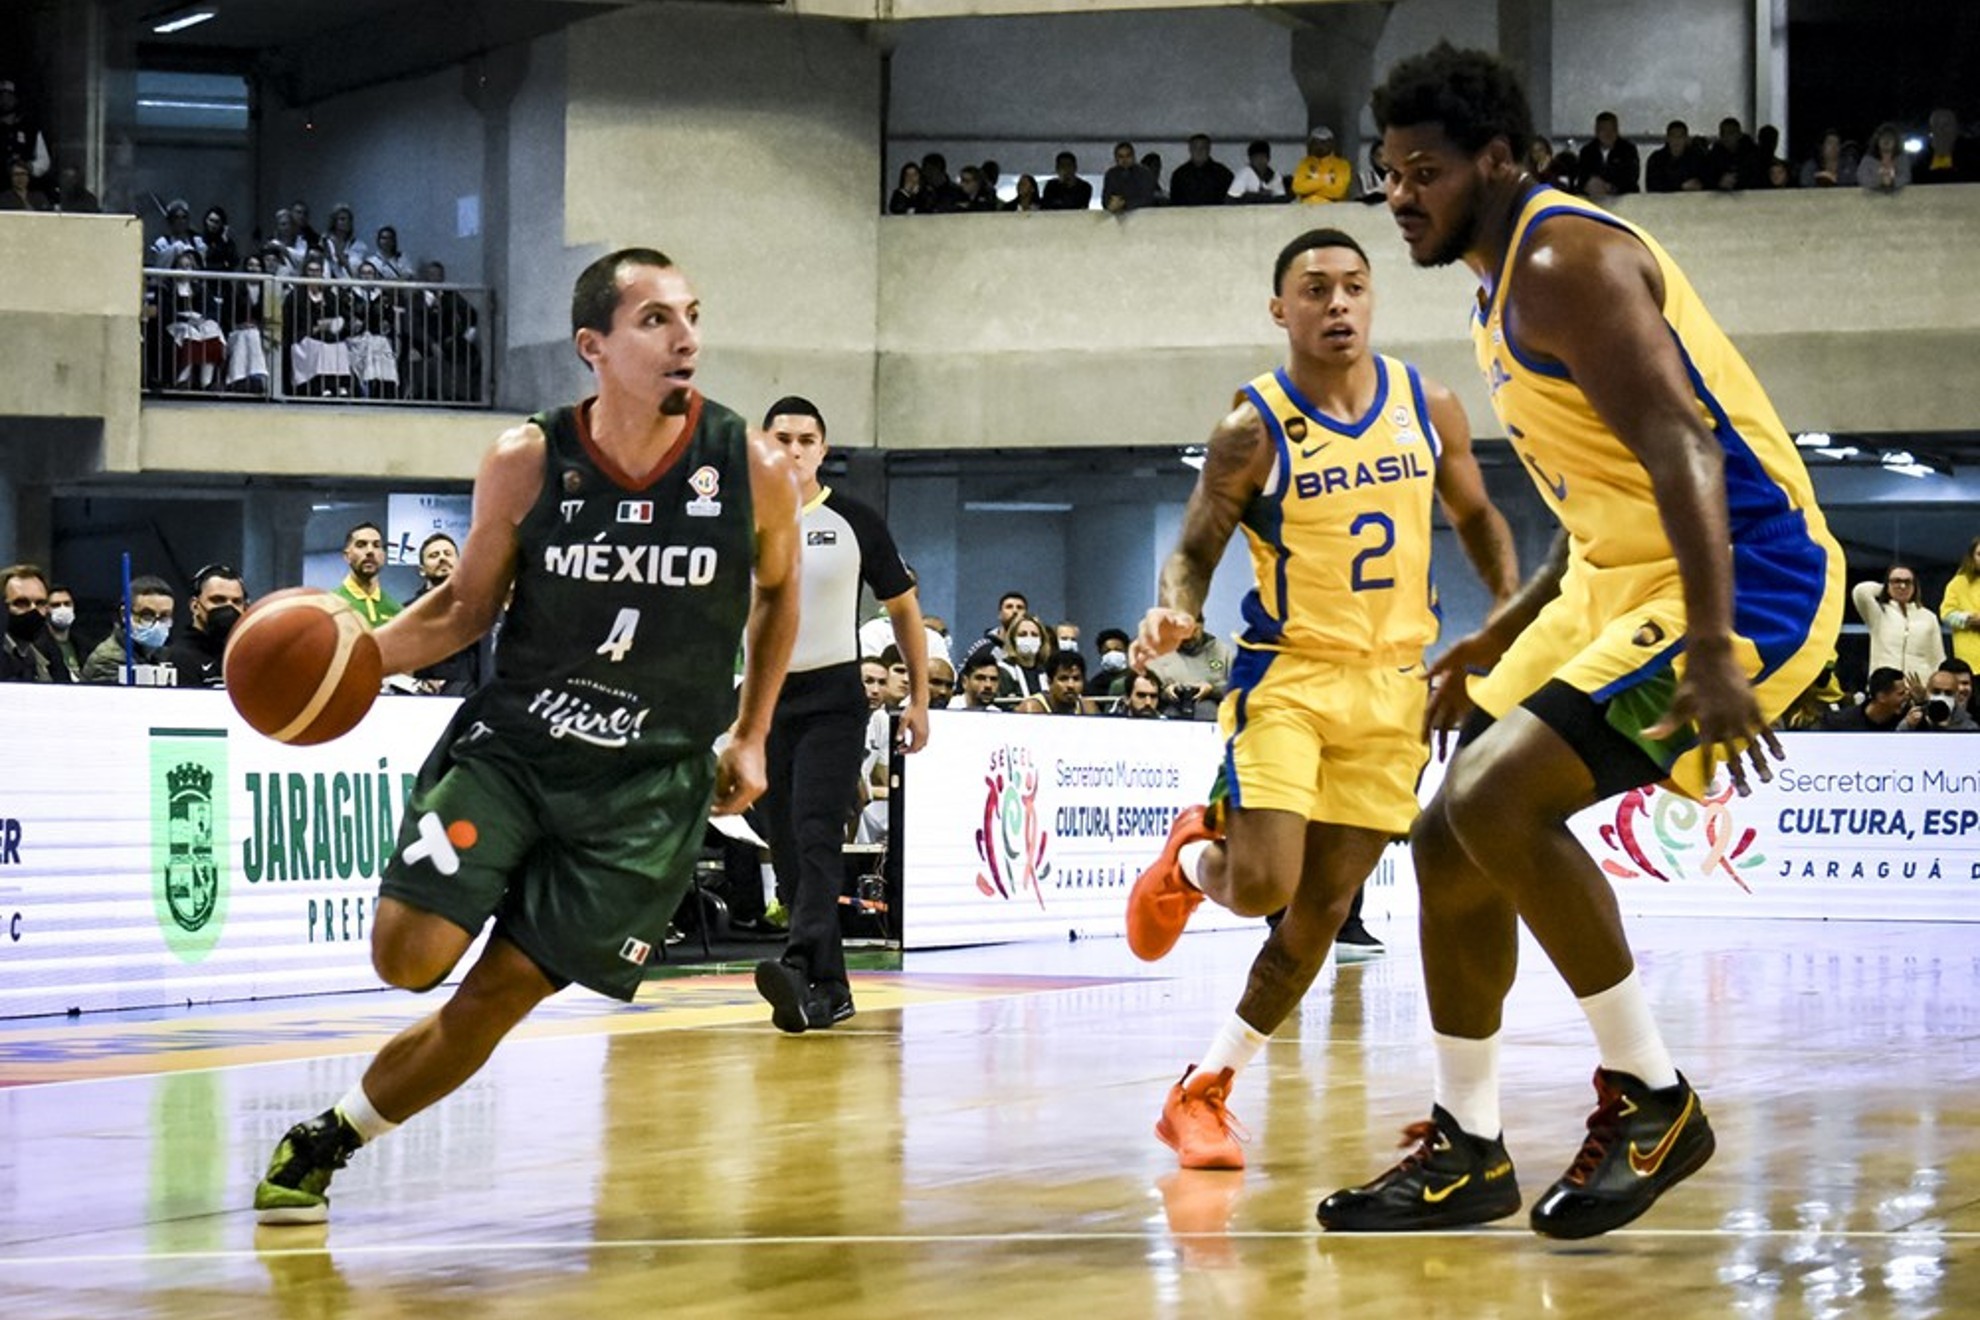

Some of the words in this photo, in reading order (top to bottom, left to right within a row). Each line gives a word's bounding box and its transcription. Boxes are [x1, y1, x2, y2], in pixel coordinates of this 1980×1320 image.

[1294, 452, 1428, 500] BRASIL
[544, 531, 718, 587] MÉXICO
[1349, 511, 1395, 592] 2
[596, 607, 641, 663] 4
[1778, 767, 1914, 793] Secretaria
[243, 757, 396, 883] JARAGUÁ
[1056, 806, 1114, 842] CULTURA,
[1116, 806, 1170, 837] ESPORTE
[1778, 808, 1916, 840] CULTURA,
[1922, 810, 1980, 836] ESP
[1056, 863, 1126, 889] JARAGUÁ
[1779, 858, 1942, 879] JARAGUÁ
[308, 897, 378, 943] PREF
